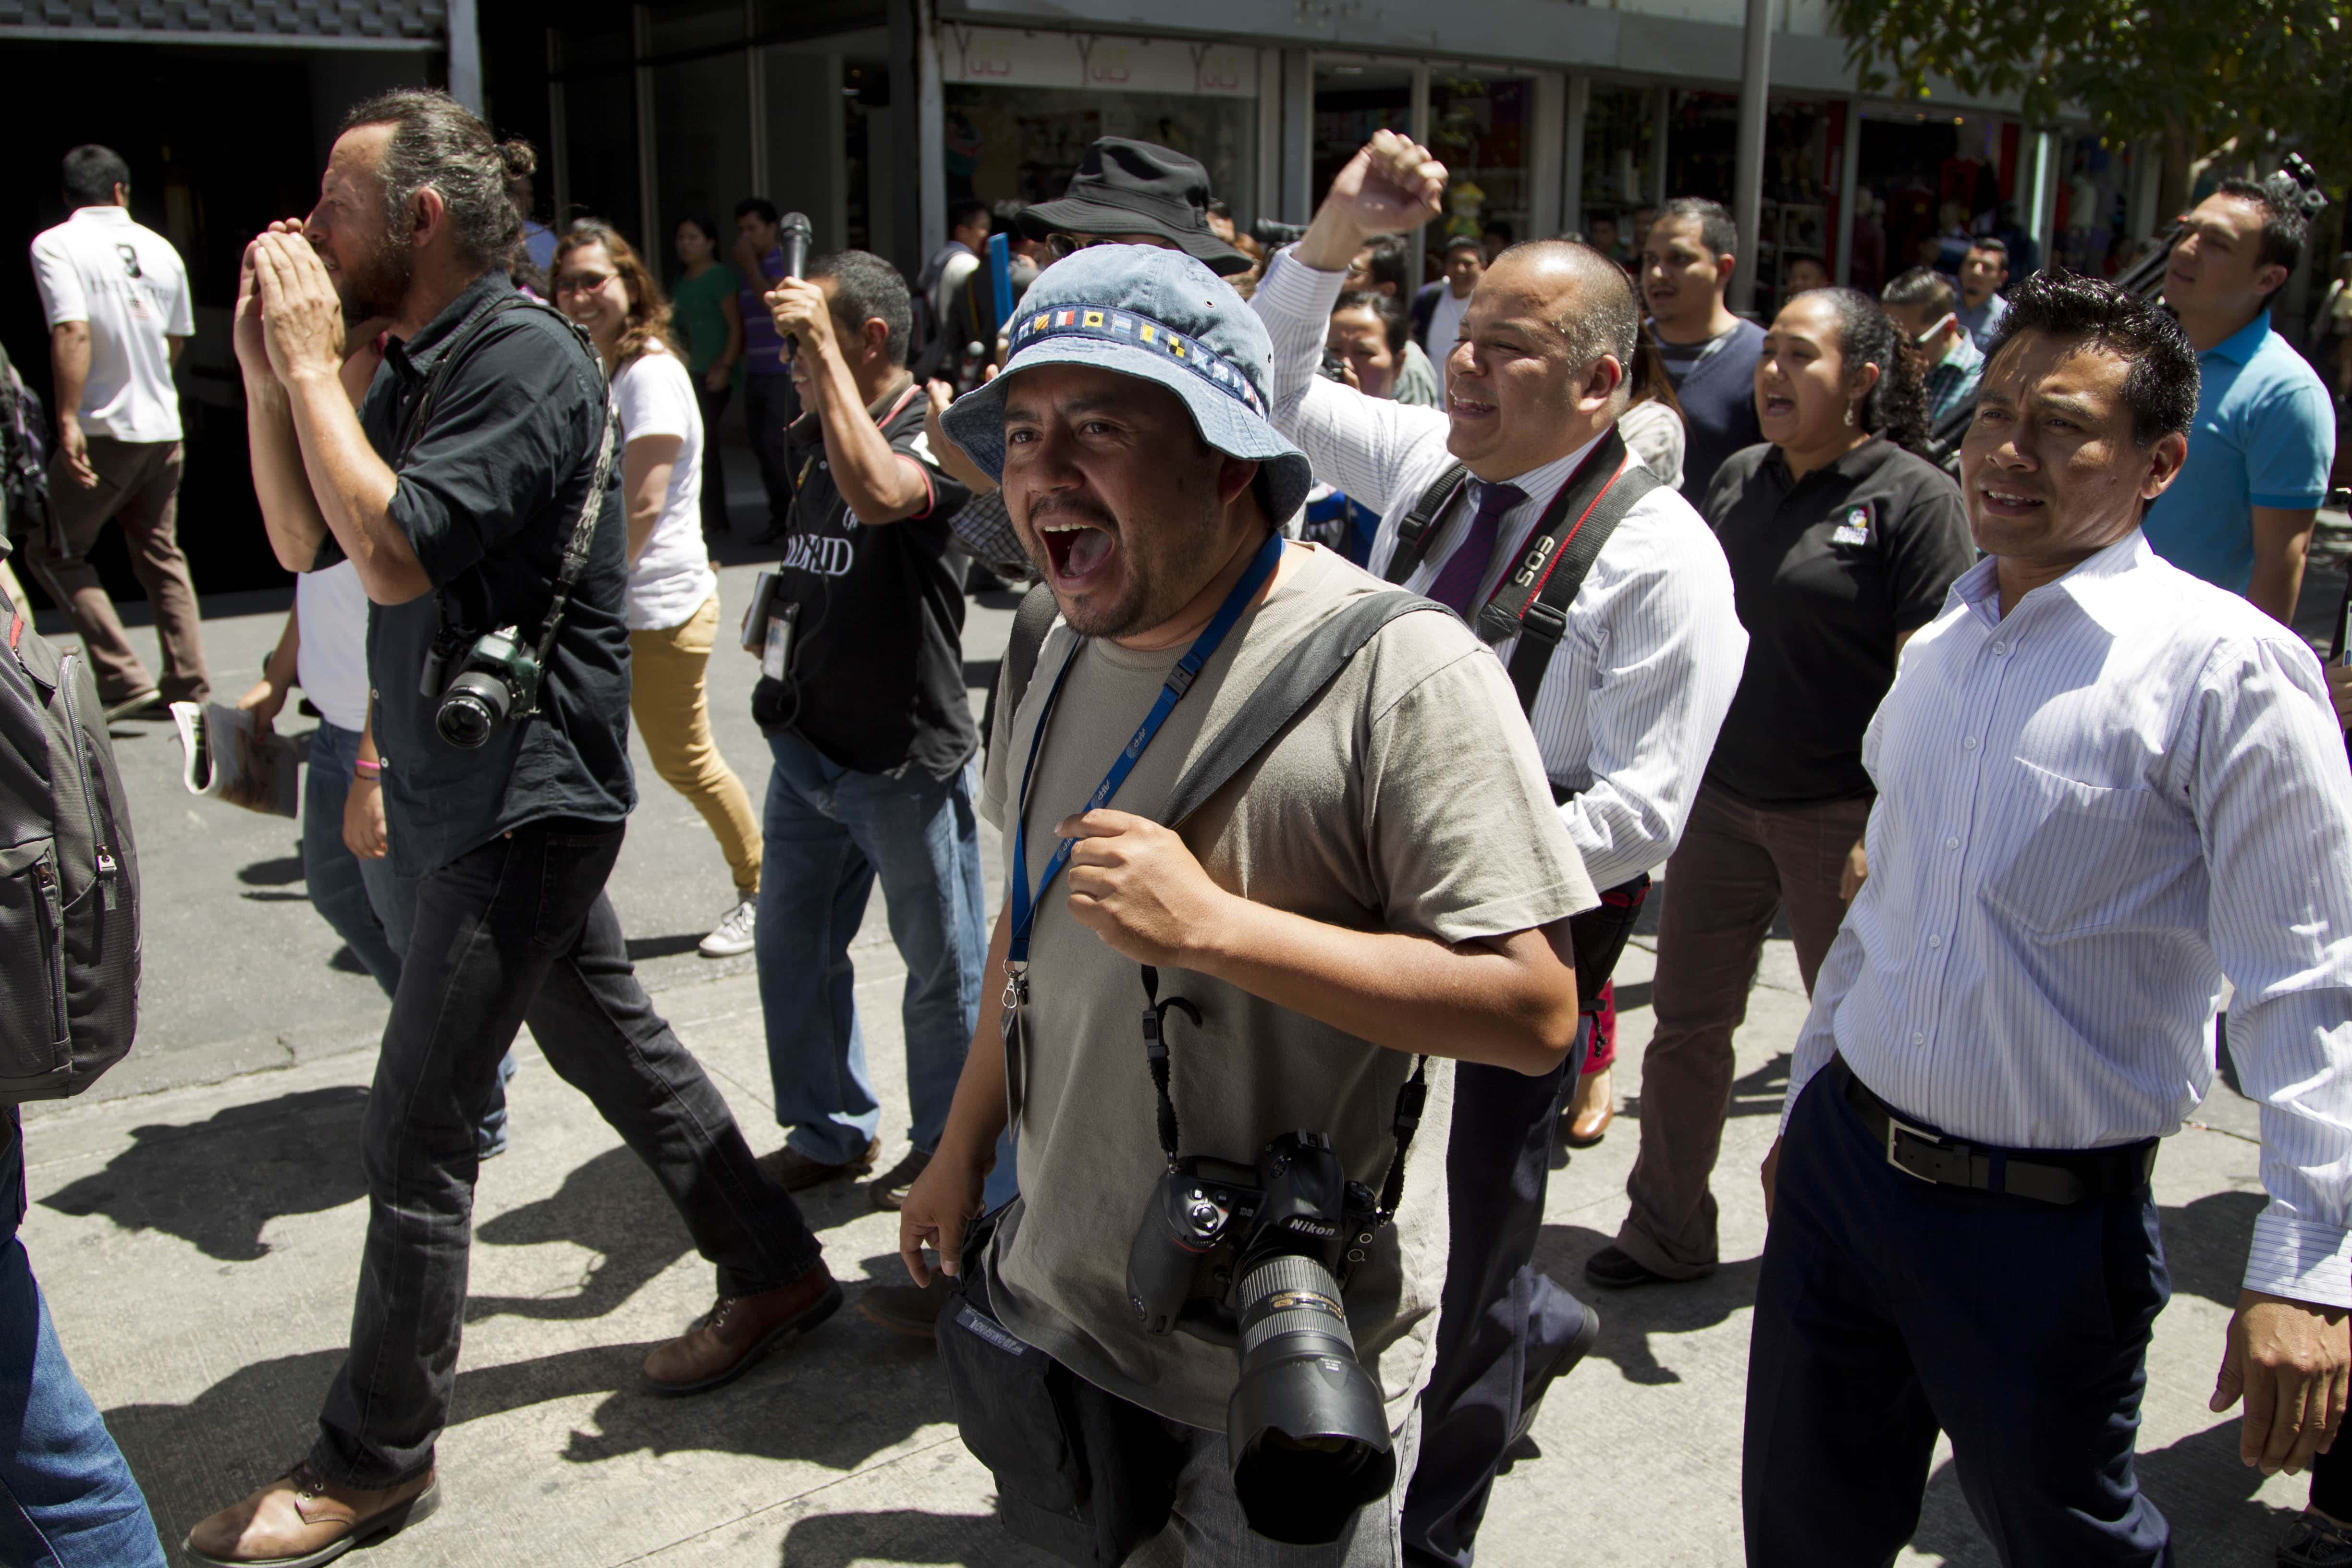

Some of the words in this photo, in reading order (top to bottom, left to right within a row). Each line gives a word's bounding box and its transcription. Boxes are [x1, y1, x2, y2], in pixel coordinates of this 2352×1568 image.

[782, 534, 854, 576] ADRID
[1515, 535, 1555, 587] EOS
[1134, 727, 1145, 747] AFP
[1098, 779, 1110, 800] AFP
[1289, 1219, 1335, 1236] Nikon
